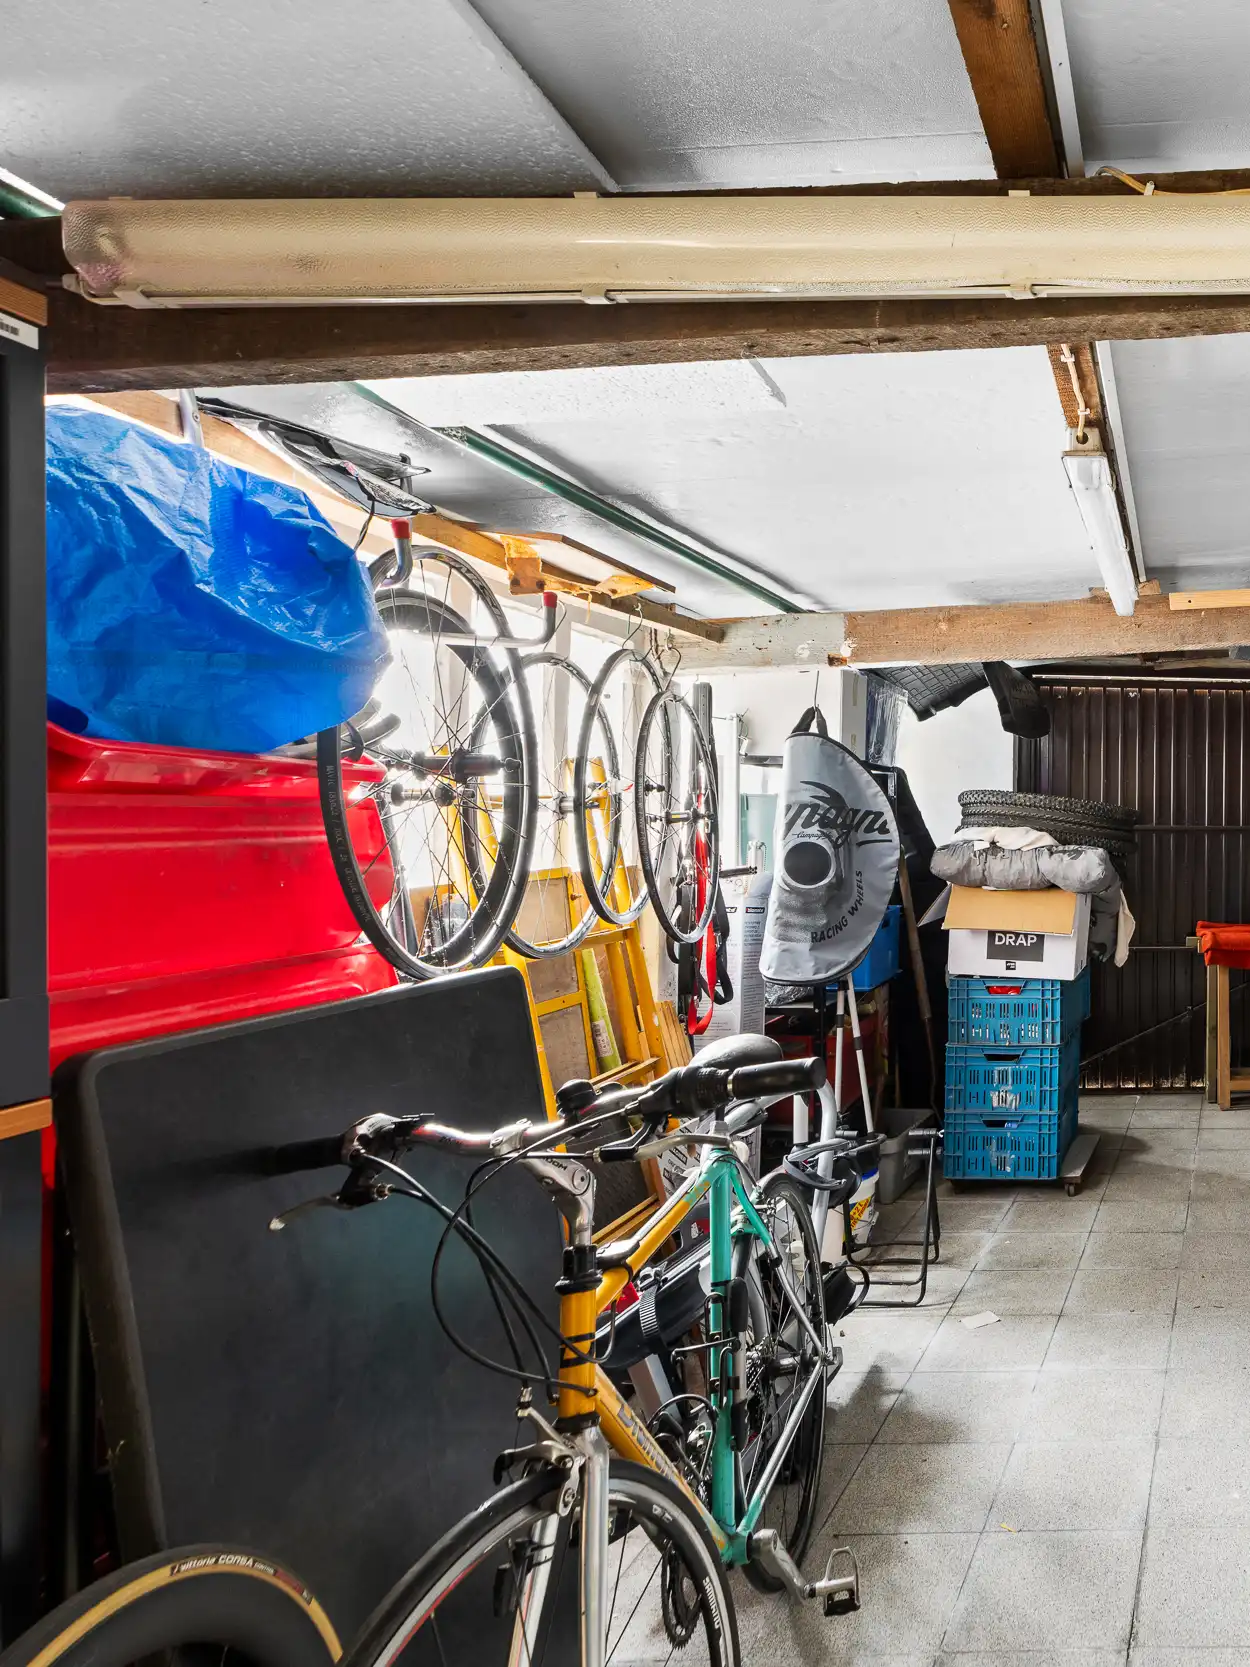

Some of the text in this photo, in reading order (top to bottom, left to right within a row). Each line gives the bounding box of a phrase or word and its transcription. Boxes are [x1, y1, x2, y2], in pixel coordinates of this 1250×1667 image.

[810, 870, 864, 943] RACING WHEELS
[994, 932, 1038, 947] DRAP
[543, 1158, 568, 1171] OOM
[218, 1554, 254, 1567] CORSA
[702, 1575, 721, 1630] SHIMANO
